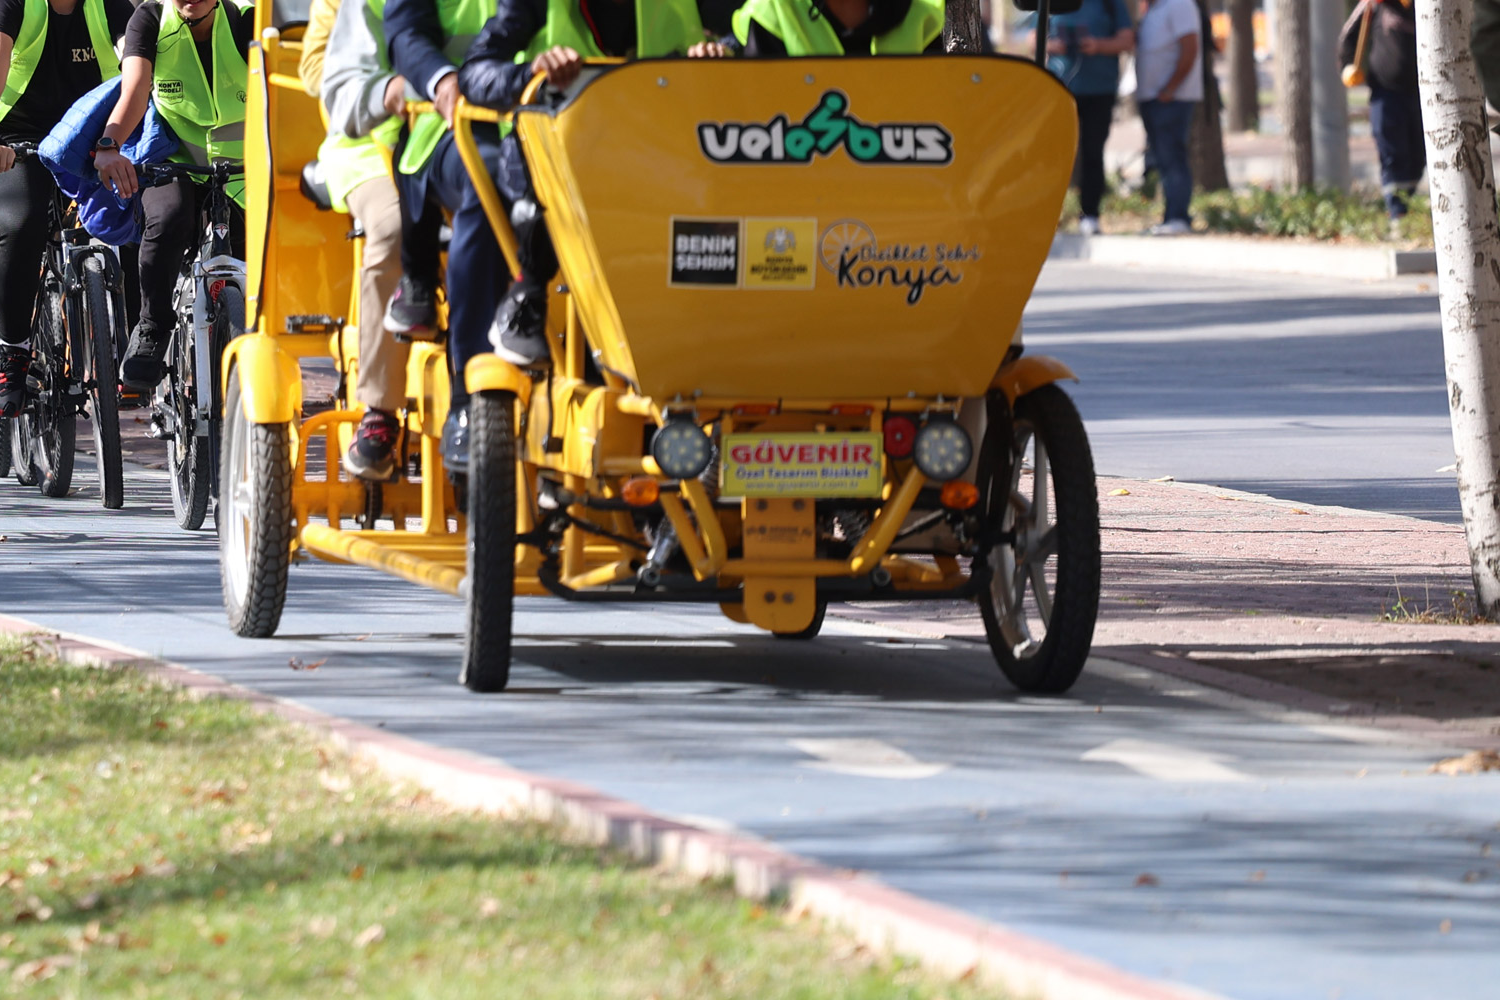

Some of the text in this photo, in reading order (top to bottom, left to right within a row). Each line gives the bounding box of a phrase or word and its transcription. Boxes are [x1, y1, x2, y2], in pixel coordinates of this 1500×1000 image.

[675, 234, 737, 254] BENİM
[675, 254, 736, 272] ŞEHRİM
[838, 248, 963, 306] Konya
[730, 439, 874, 465] GÜVENİR
